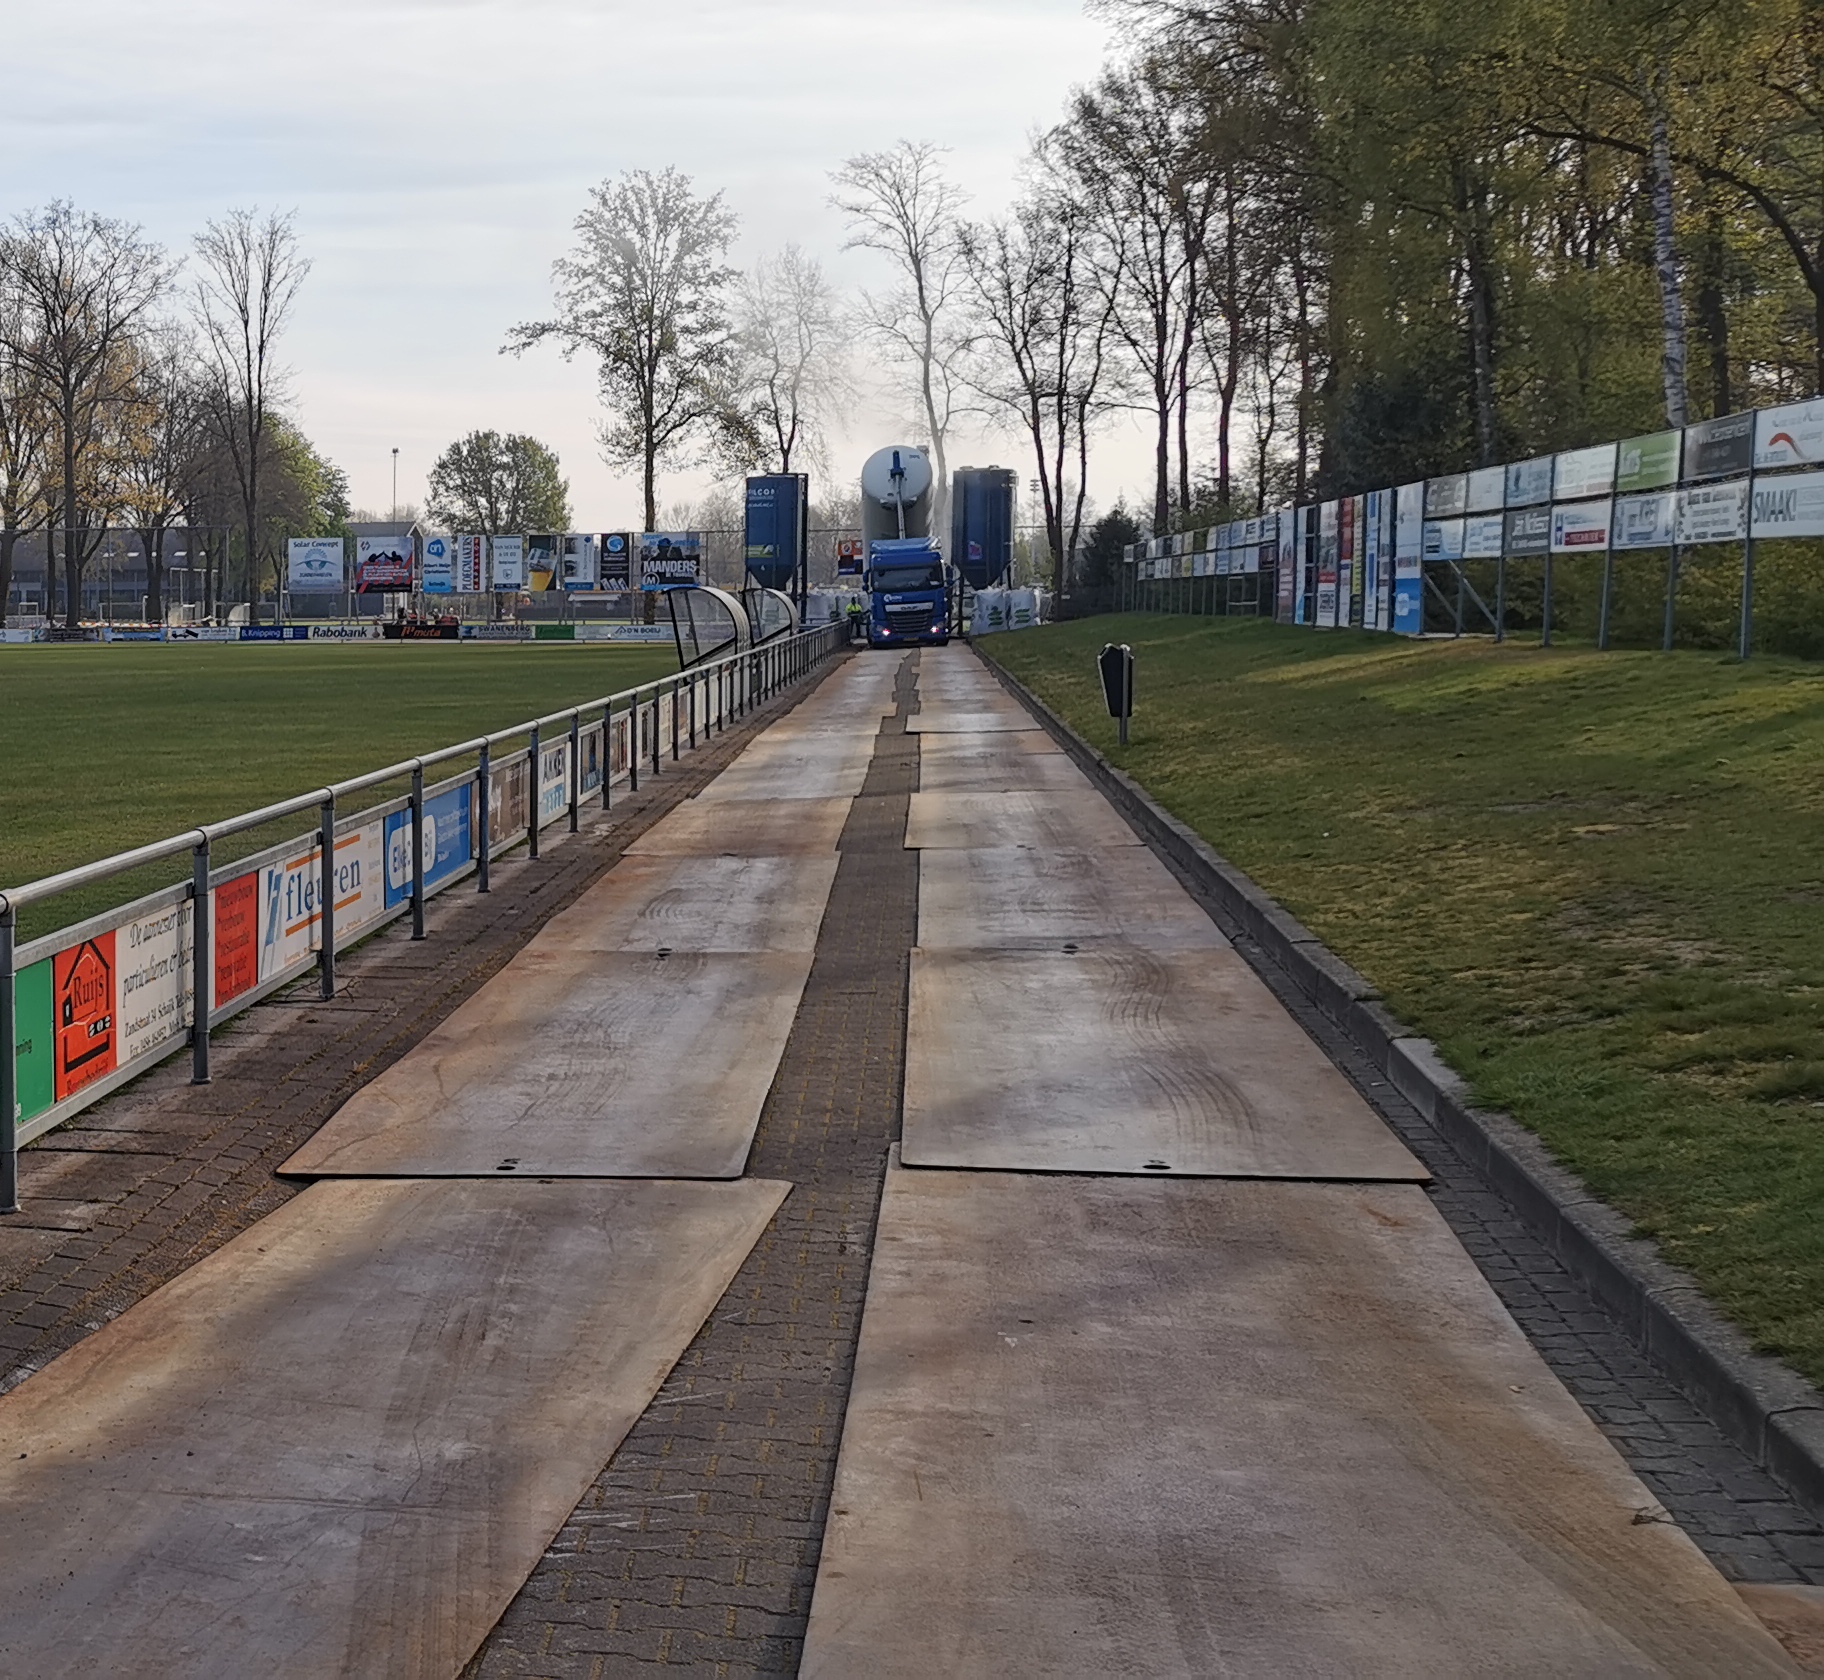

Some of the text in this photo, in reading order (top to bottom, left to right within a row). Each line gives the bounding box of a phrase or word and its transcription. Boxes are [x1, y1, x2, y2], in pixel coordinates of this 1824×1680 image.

[1754, 489, 1797, 524] SMAAK!
[643, 559, 697, 573] MANDERS
[312, 626, 367, 638] Rabobank
[72, 968, 105, 1011] Ruijs
